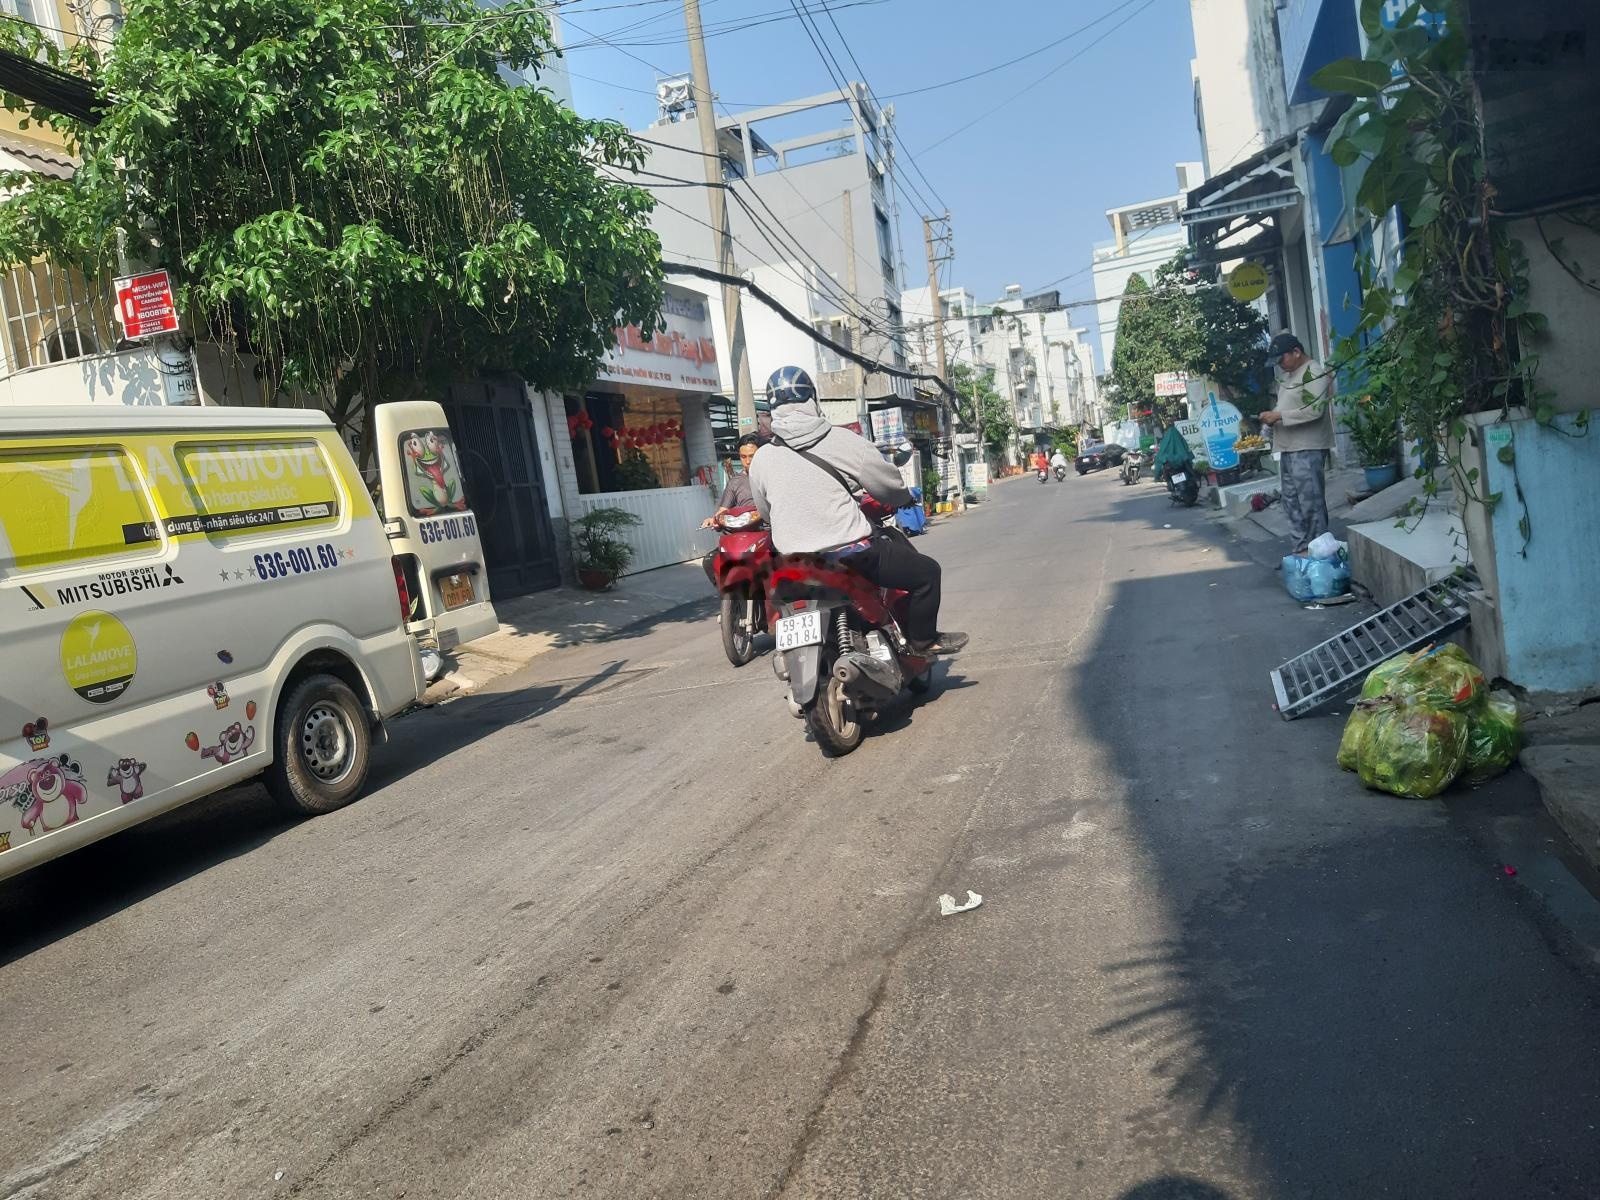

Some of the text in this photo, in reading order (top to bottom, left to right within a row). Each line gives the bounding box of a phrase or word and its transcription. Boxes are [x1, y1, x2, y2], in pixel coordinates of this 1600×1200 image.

[106, 442, 327, 492] LALAMOVE
[259, 511, 274, 523] 24/7
[98, 566, 155, 581] MOTOR SPORT
[56, 573, 161, 605] MITSUBISHI
[67, 645, 132, 670] LALAMOVE
